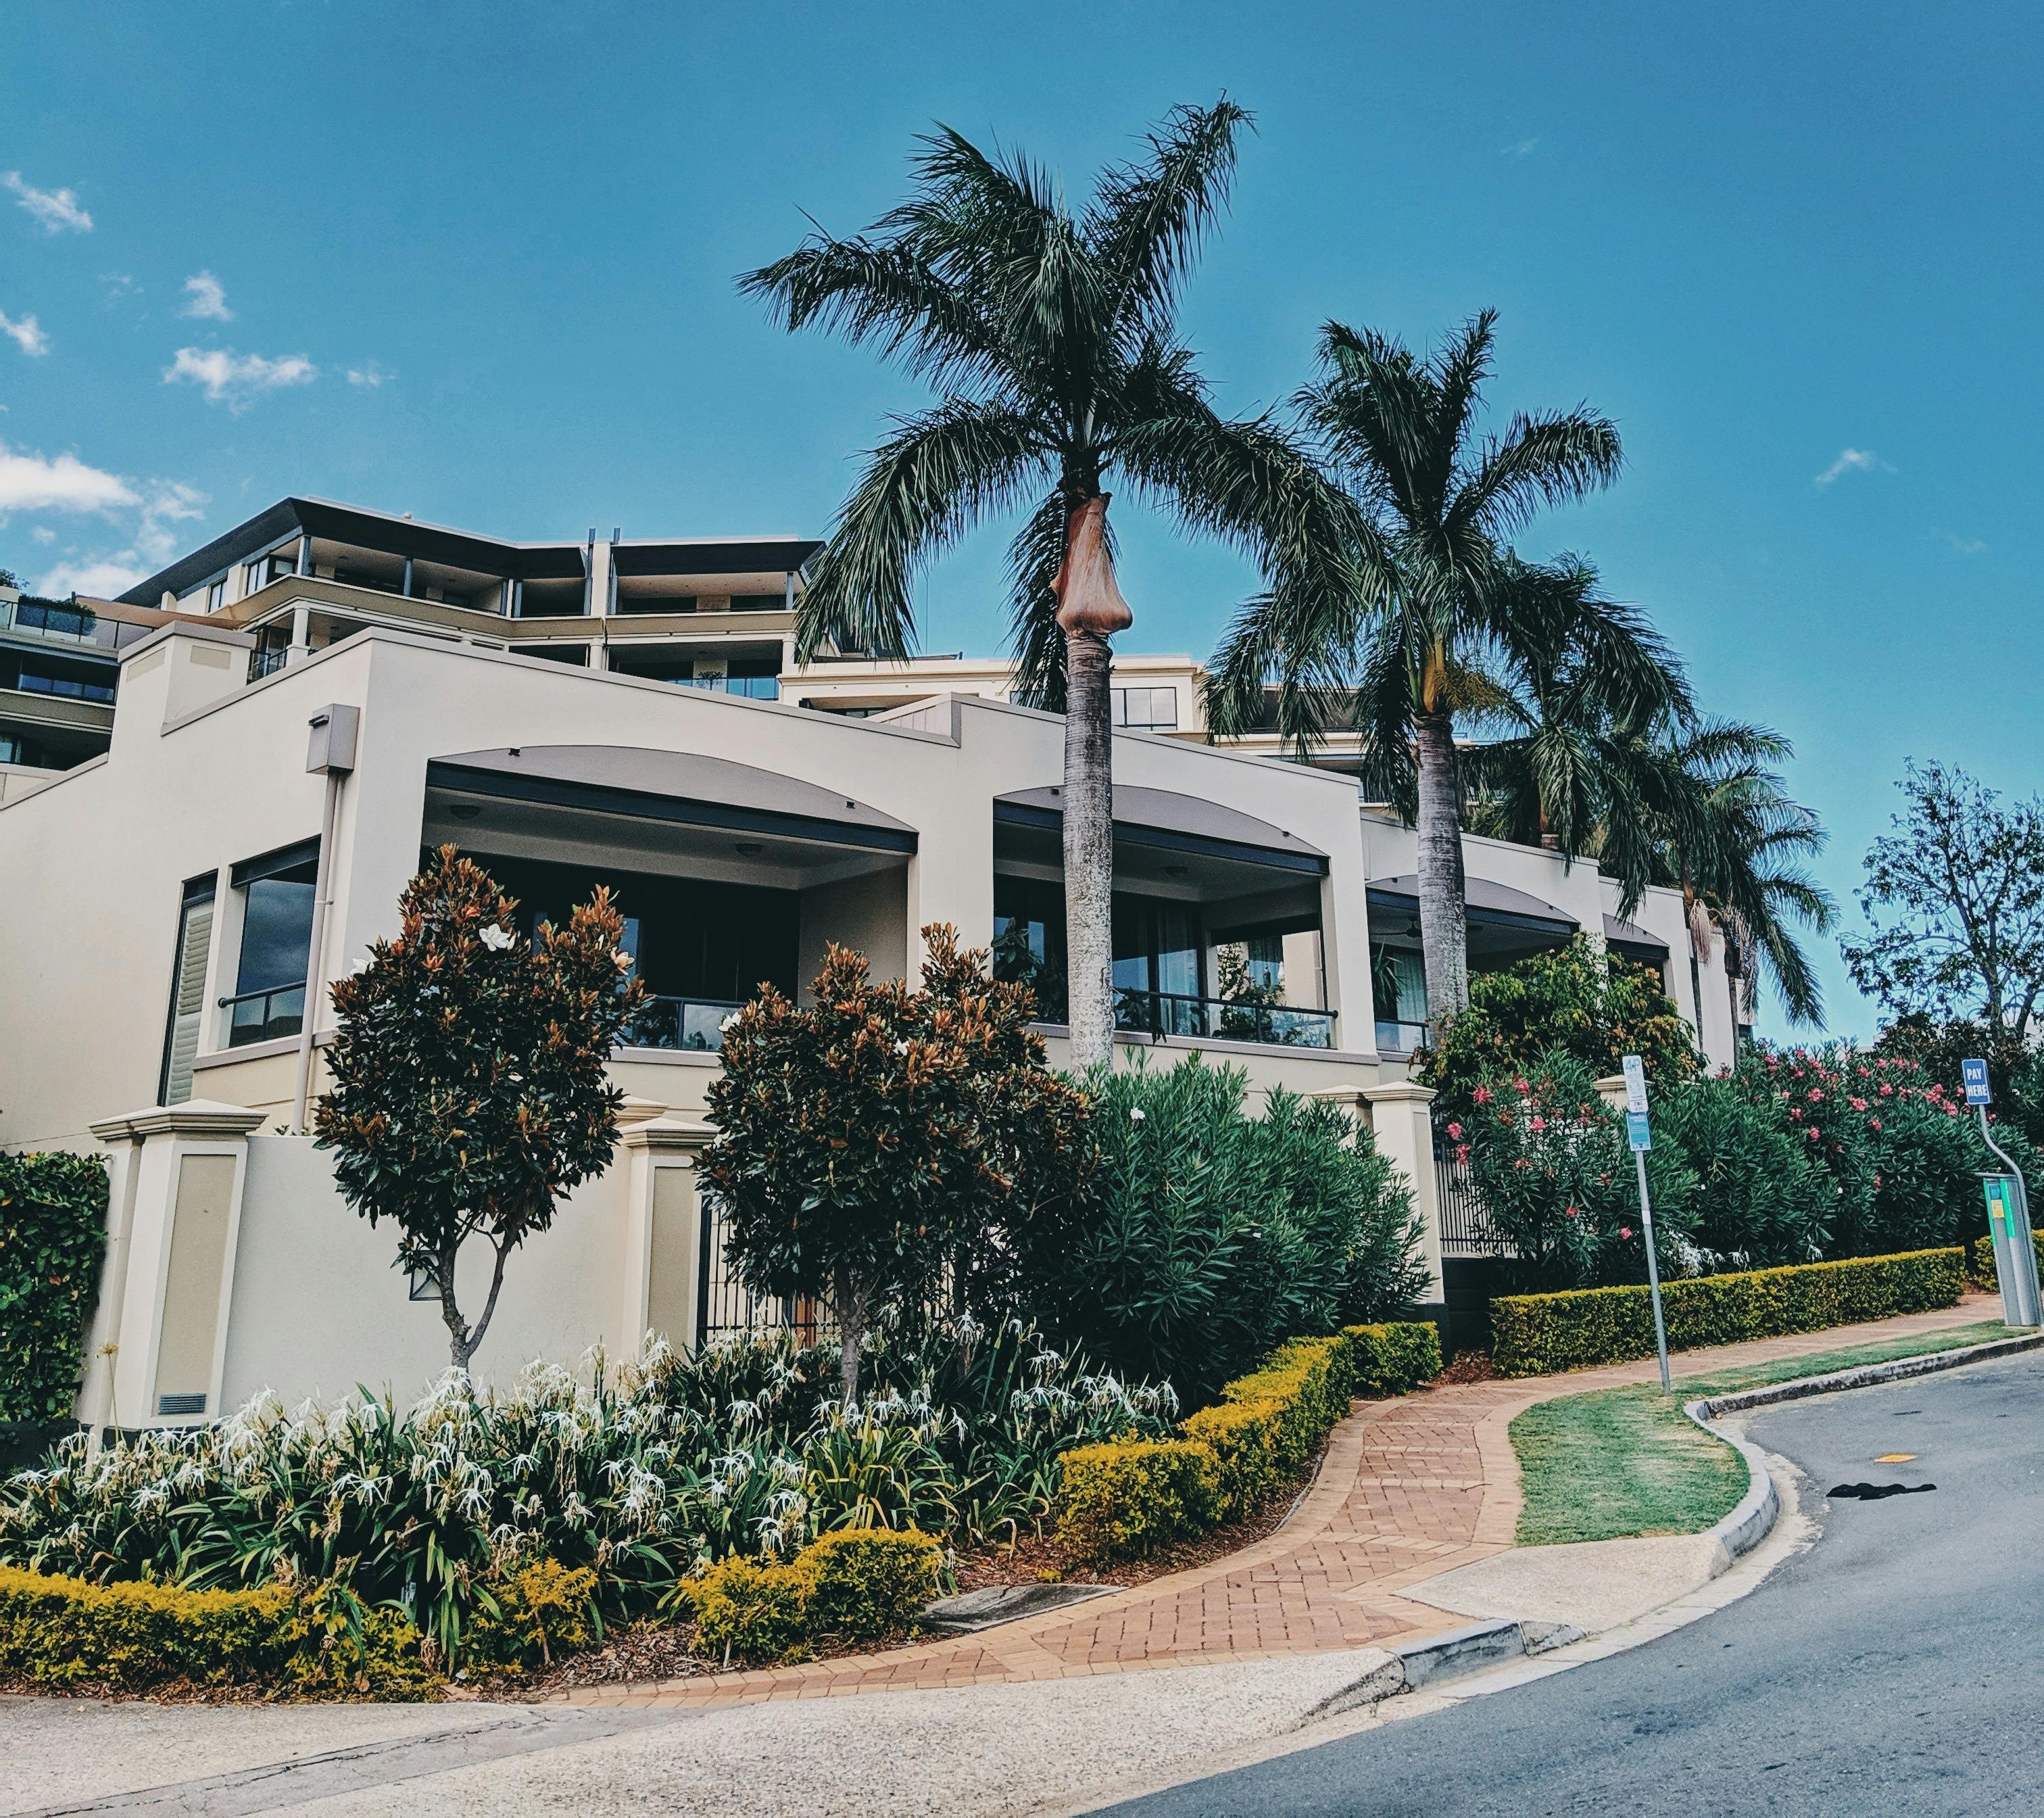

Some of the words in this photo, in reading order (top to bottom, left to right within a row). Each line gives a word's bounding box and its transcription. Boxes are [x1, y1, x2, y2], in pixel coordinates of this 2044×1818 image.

[1626, 1059, 1640, 1072] 4P
[1967, 1068, 1982, 1080] PAY
[1968, 1084, 1987, 1097] HERE
